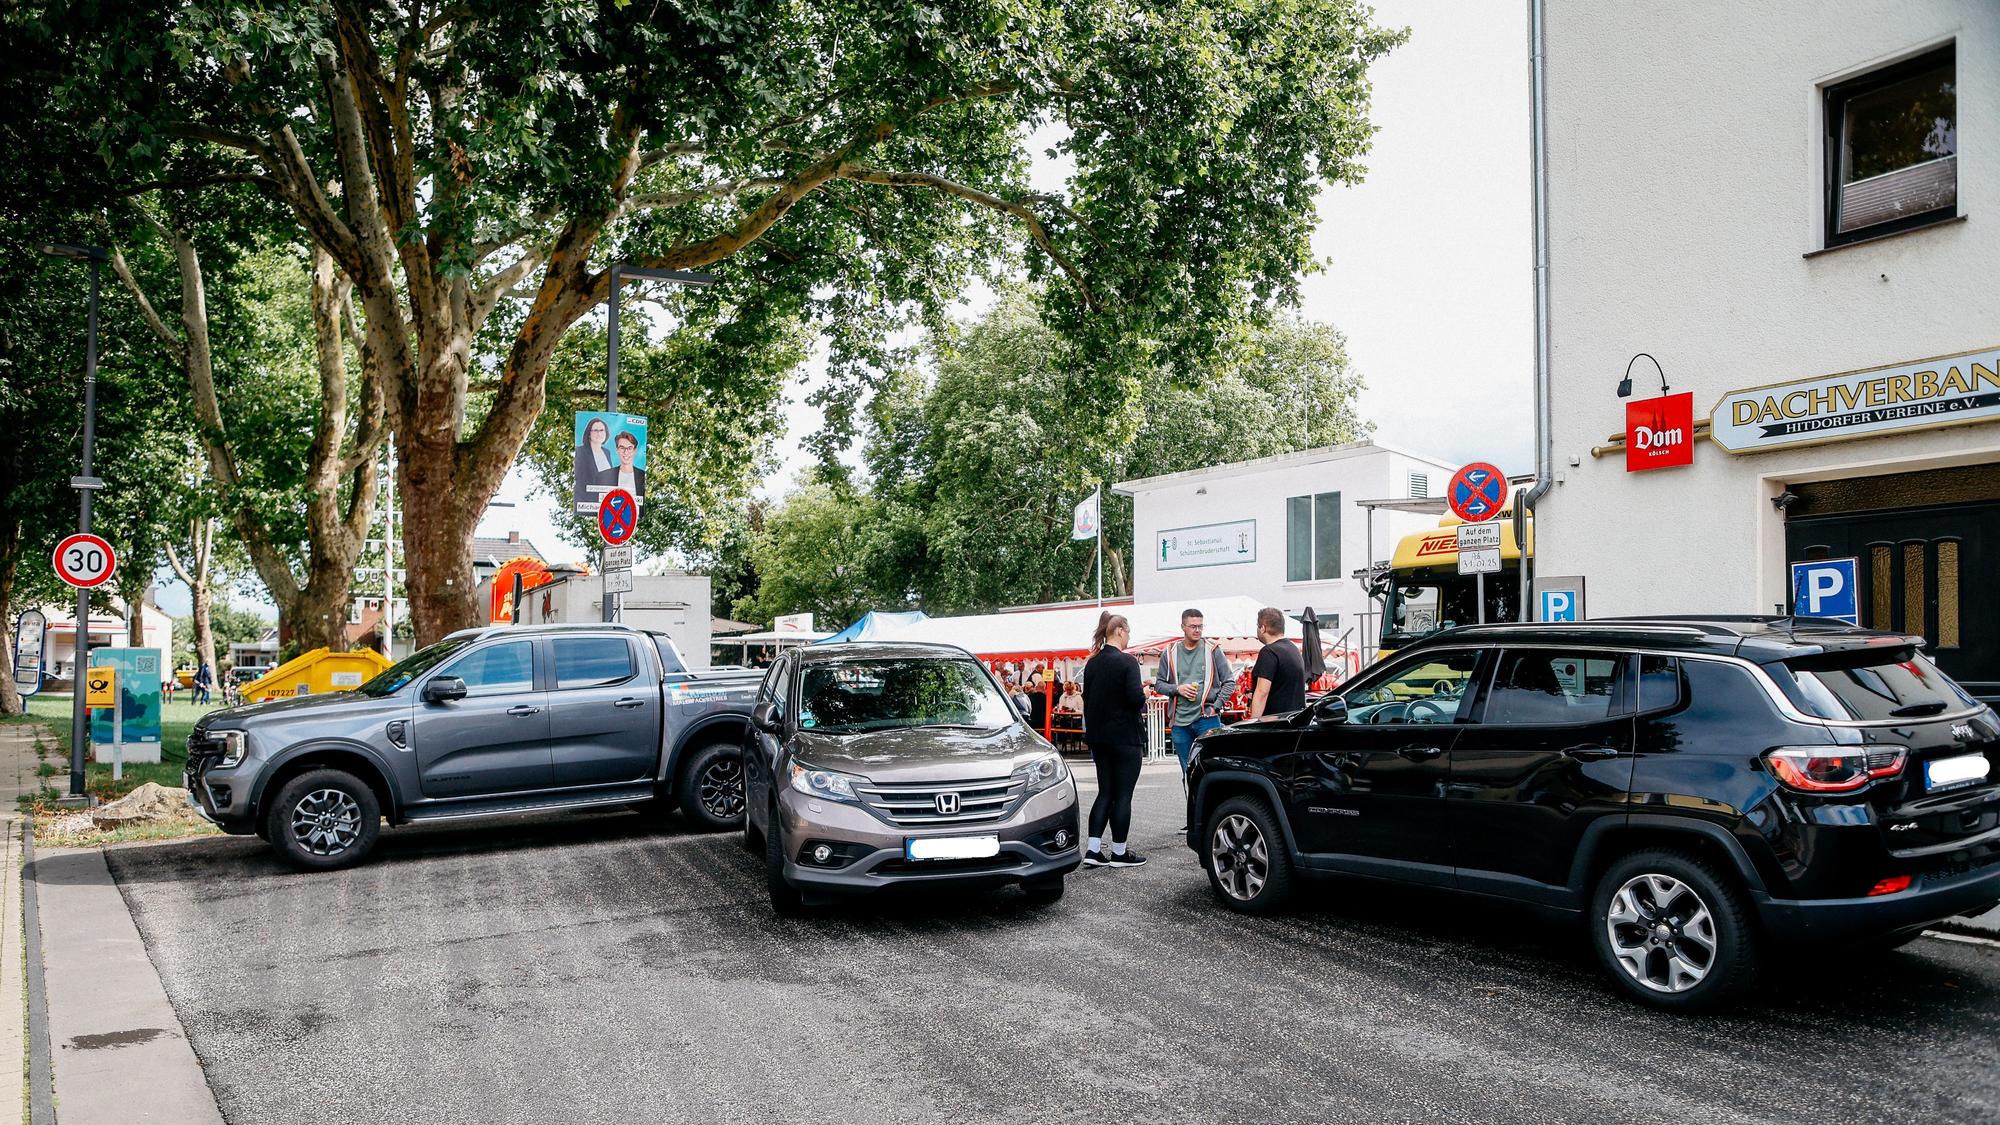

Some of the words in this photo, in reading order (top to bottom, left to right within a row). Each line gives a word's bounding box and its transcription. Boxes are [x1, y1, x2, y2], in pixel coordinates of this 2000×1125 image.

[1785, 411, 1872, 434] HITDORFER
[1875, 402, 1946, 421] VEREINE
[1949, 397, 1980, 411] e.V.
[1634, 426, 1682, 449] Dom
[1465, 528, 1477, 536] Auf
[1478, 527, 1492, 535] dem
[1459, 537, 1481, 547] ganzen
[1483, 536, 1499, 544] Platz
[67, 548, 103, 573] 30
[605, 560, 620, 568] ganzen
[1807, 568, 1844, 614] P
[1547, 592, 1569, 622] P
[267, 689, 295, 697] 107227
[1951, 723, 1974, 738] Jeep
